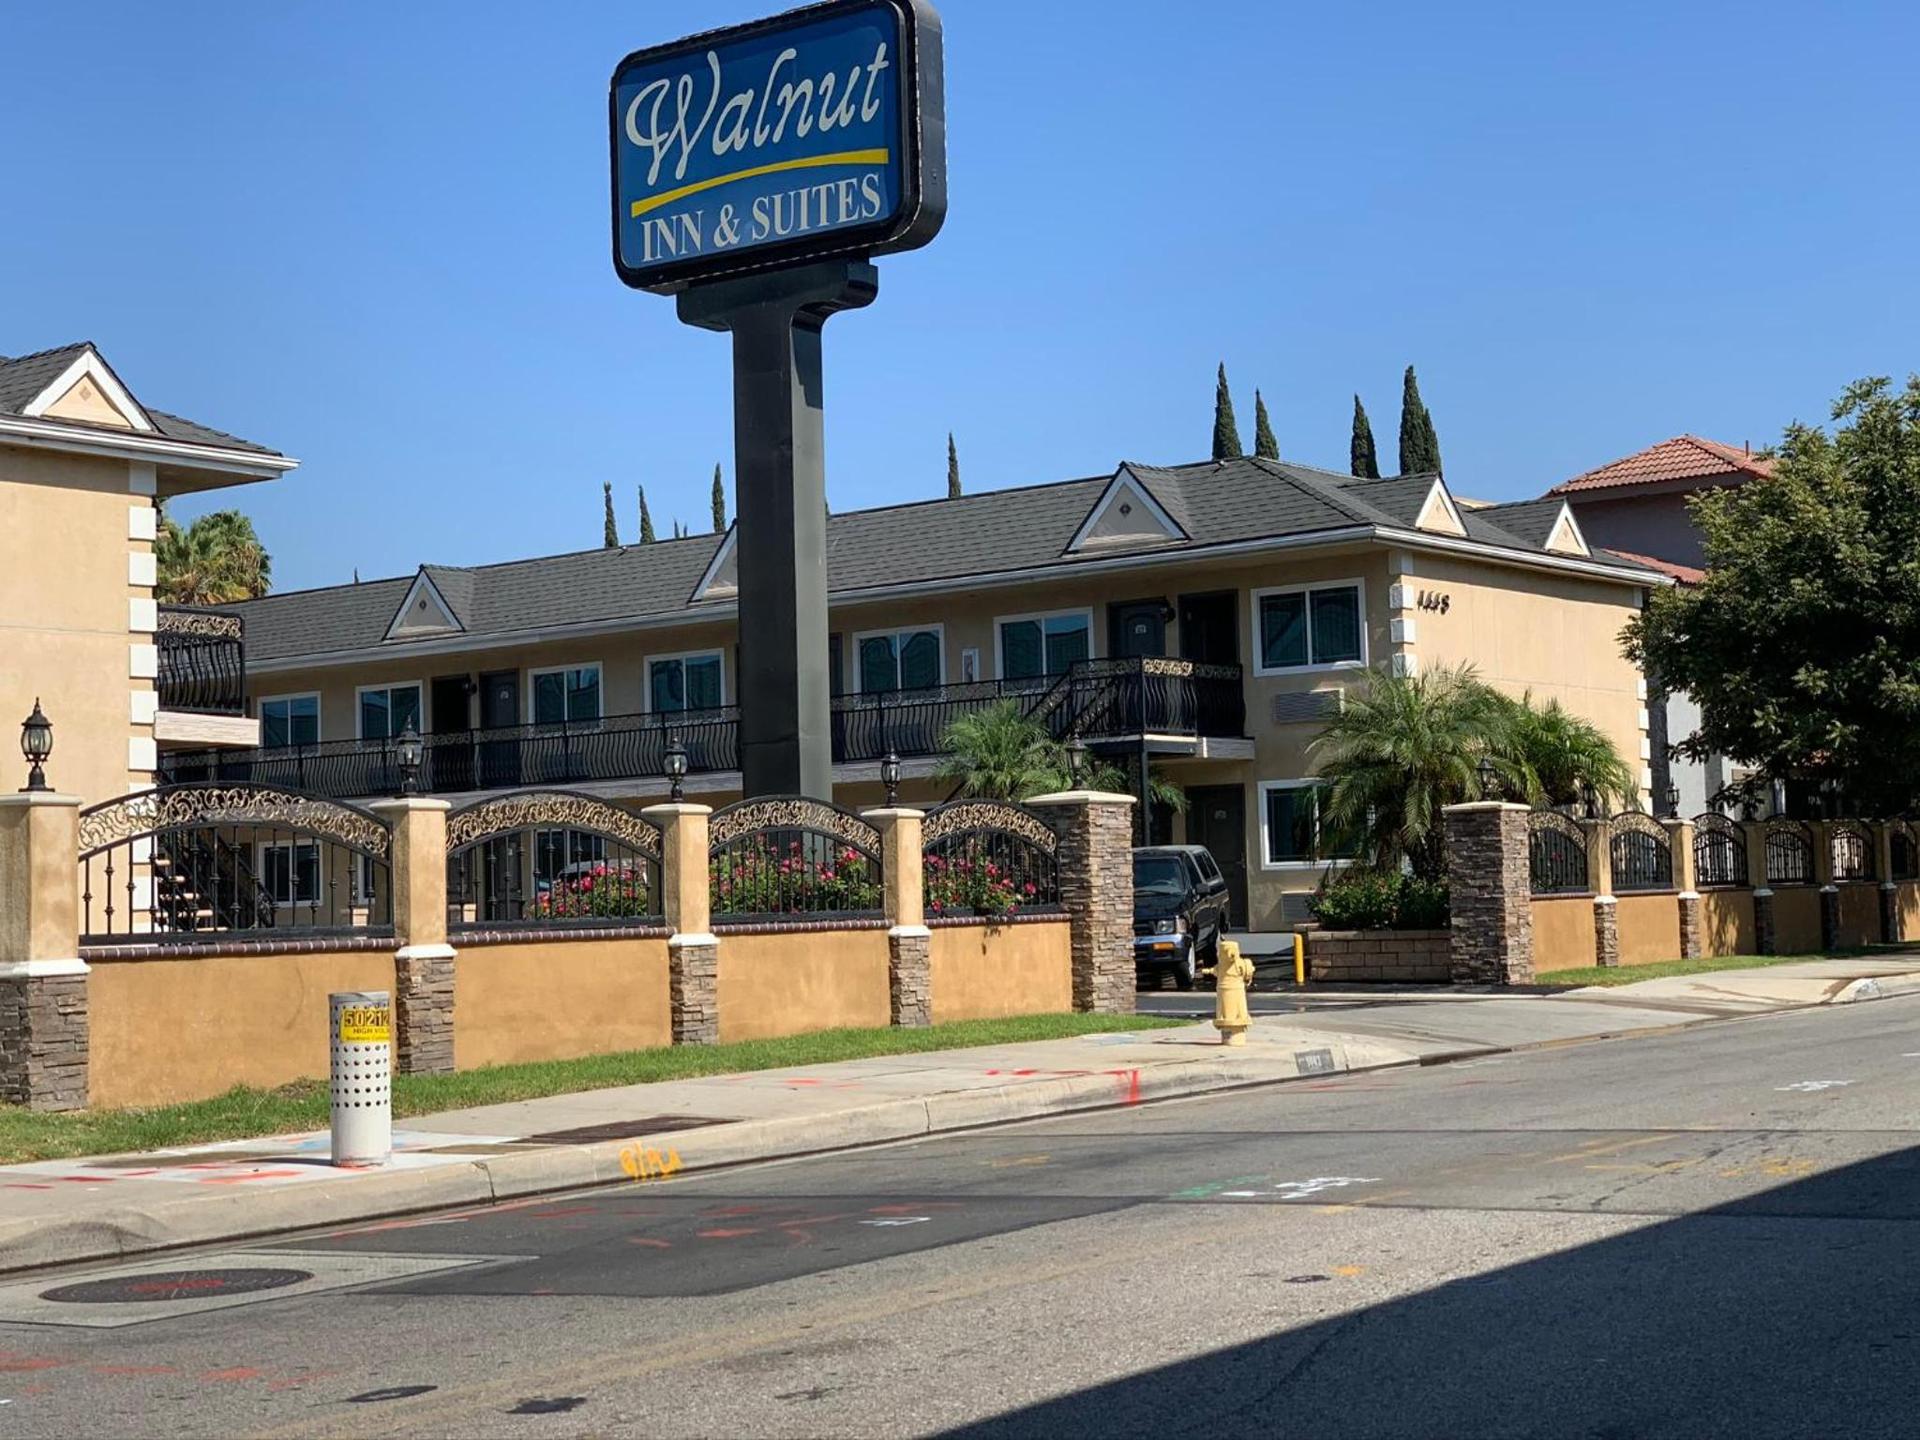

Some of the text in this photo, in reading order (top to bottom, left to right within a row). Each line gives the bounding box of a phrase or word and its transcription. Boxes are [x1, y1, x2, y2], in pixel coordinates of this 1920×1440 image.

[625, 42, 889, 186] Walnut
[641, 173, 881, 262] INN & SUITES
